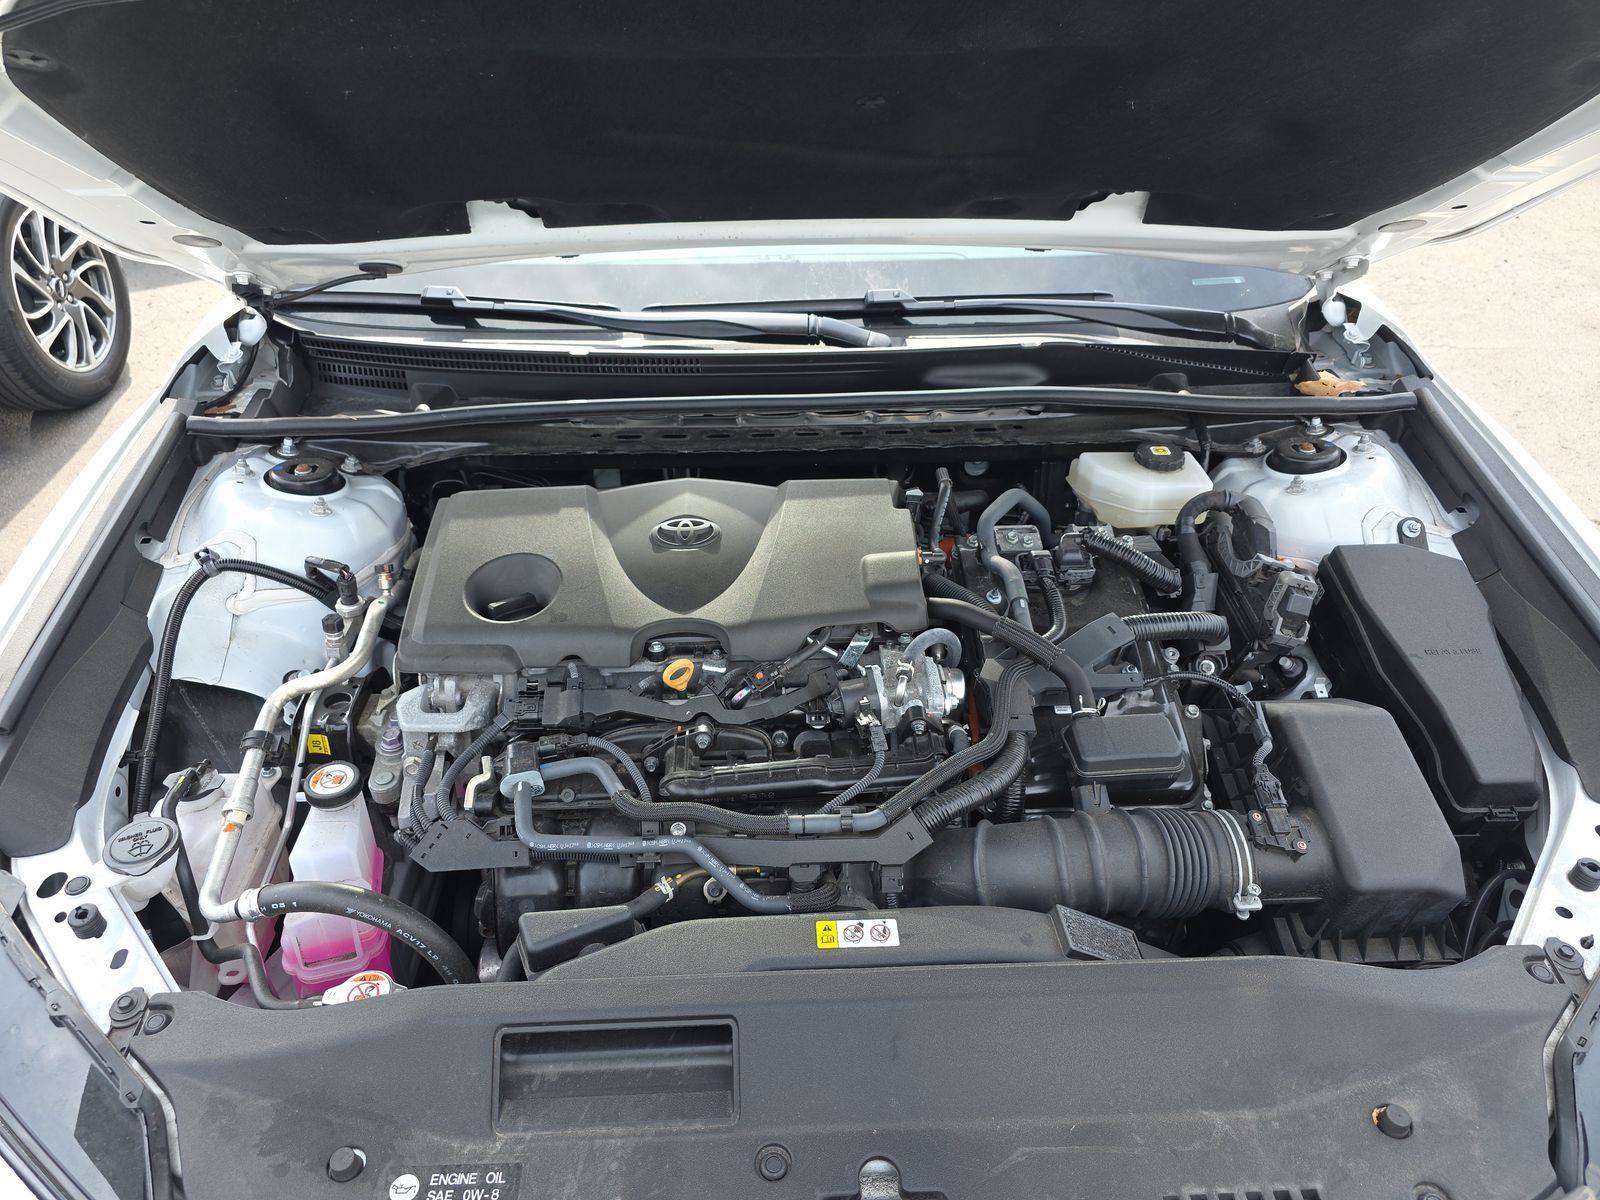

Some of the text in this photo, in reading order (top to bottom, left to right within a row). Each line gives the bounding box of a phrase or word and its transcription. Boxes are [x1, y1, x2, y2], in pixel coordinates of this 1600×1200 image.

[146, 826, 163, 834] FLUID
[356, 909, 392, 929] YOKOHAMA
[396, 928, 426, 949] ACV17
[429, 1171, 506, 1185] ENGINE OIL
[426, 1188, 500, 1200] SAE 0W-8
